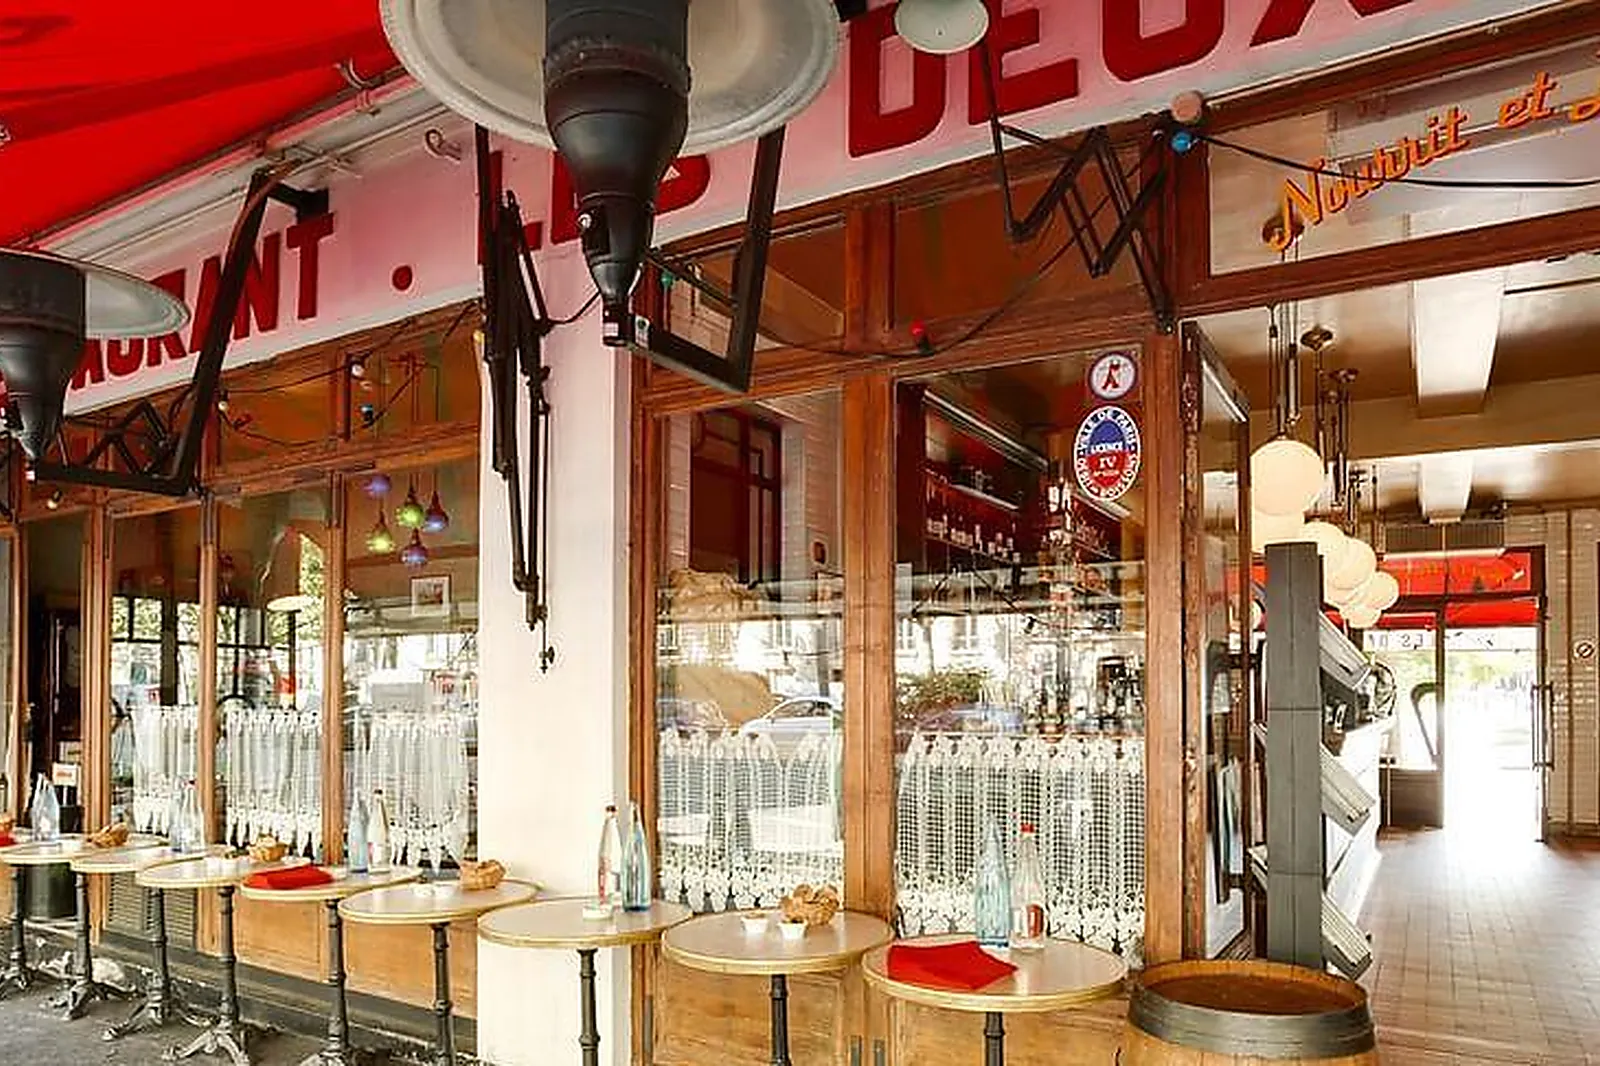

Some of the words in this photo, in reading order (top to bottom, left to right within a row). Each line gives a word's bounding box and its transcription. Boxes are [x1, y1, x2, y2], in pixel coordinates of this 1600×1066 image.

[1262, 105, 1471, 251] Nourrit
[1500, 70, 1557, 127] et
[1100, 455, 1117, 467] IV
